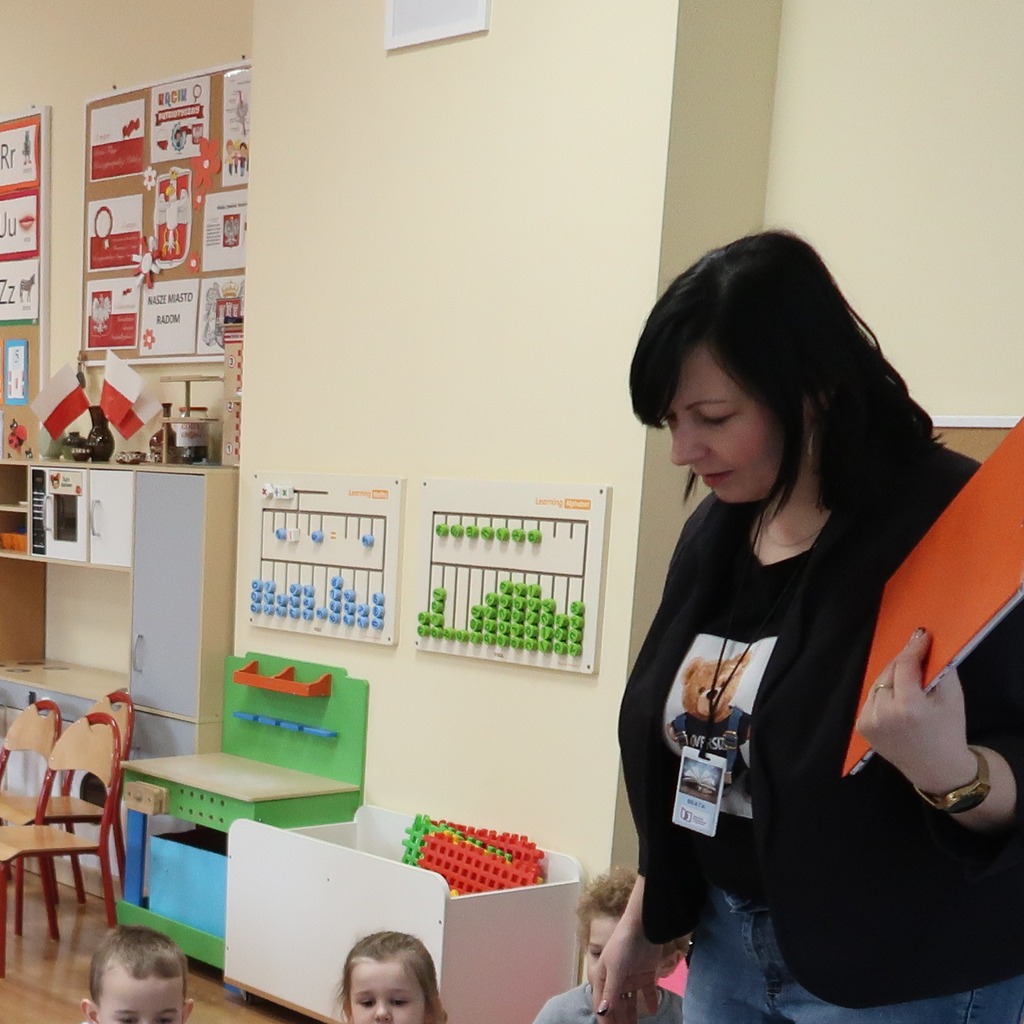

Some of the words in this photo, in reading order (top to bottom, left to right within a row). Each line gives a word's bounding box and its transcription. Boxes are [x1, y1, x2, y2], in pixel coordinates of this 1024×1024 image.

[1, 143, 16, 170] Rr
[148, 294, 167, 305] NASZE
[168, 292, 193, 304] MIASTO
[156, 314, 181, 325] RADOM
[535, 497, 564, 508] Learning
